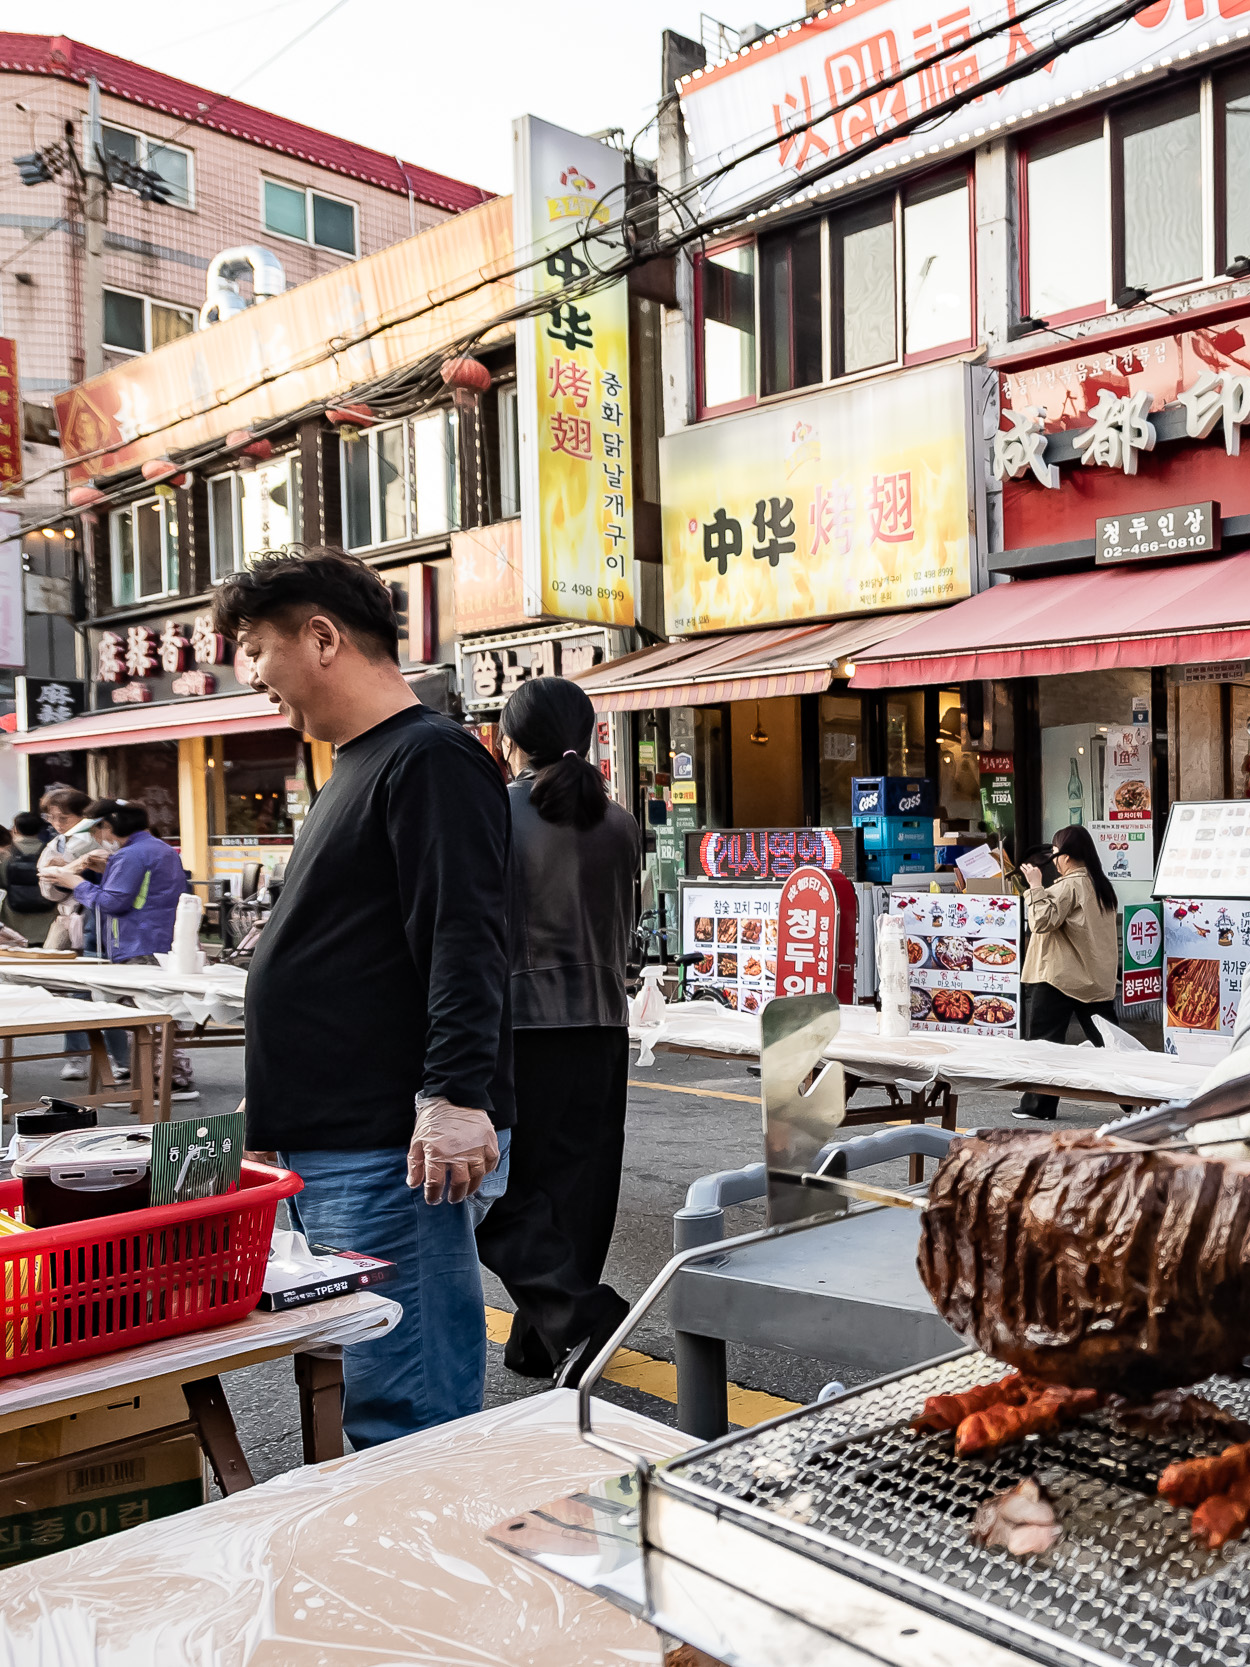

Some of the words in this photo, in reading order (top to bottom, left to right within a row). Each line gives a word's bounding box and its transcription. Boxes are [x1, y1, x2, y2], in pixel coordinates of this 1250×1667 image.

[601, 370, 627, 578] 중화닭날개구이
[1103, 507, 1205, 544] 청두인상
[1103, 533, 1206, 559] 02-466-0810
[937, 566, 954, 578] 8999
[552, 580, 567, 593] 02
[571, 583, 593, 597] 498
[597, 587, 624, 602] 8999
[906, 587, 918, 598] 010
[937, 582, 954, 594] 8999
[991, 793, 1013, 805] TERRA
[1130, 921, 1158, 946] 맥주
[1125, 975, 1162, 998] 청두인상
[315, 1281, 348, 1296] TPE장갑
